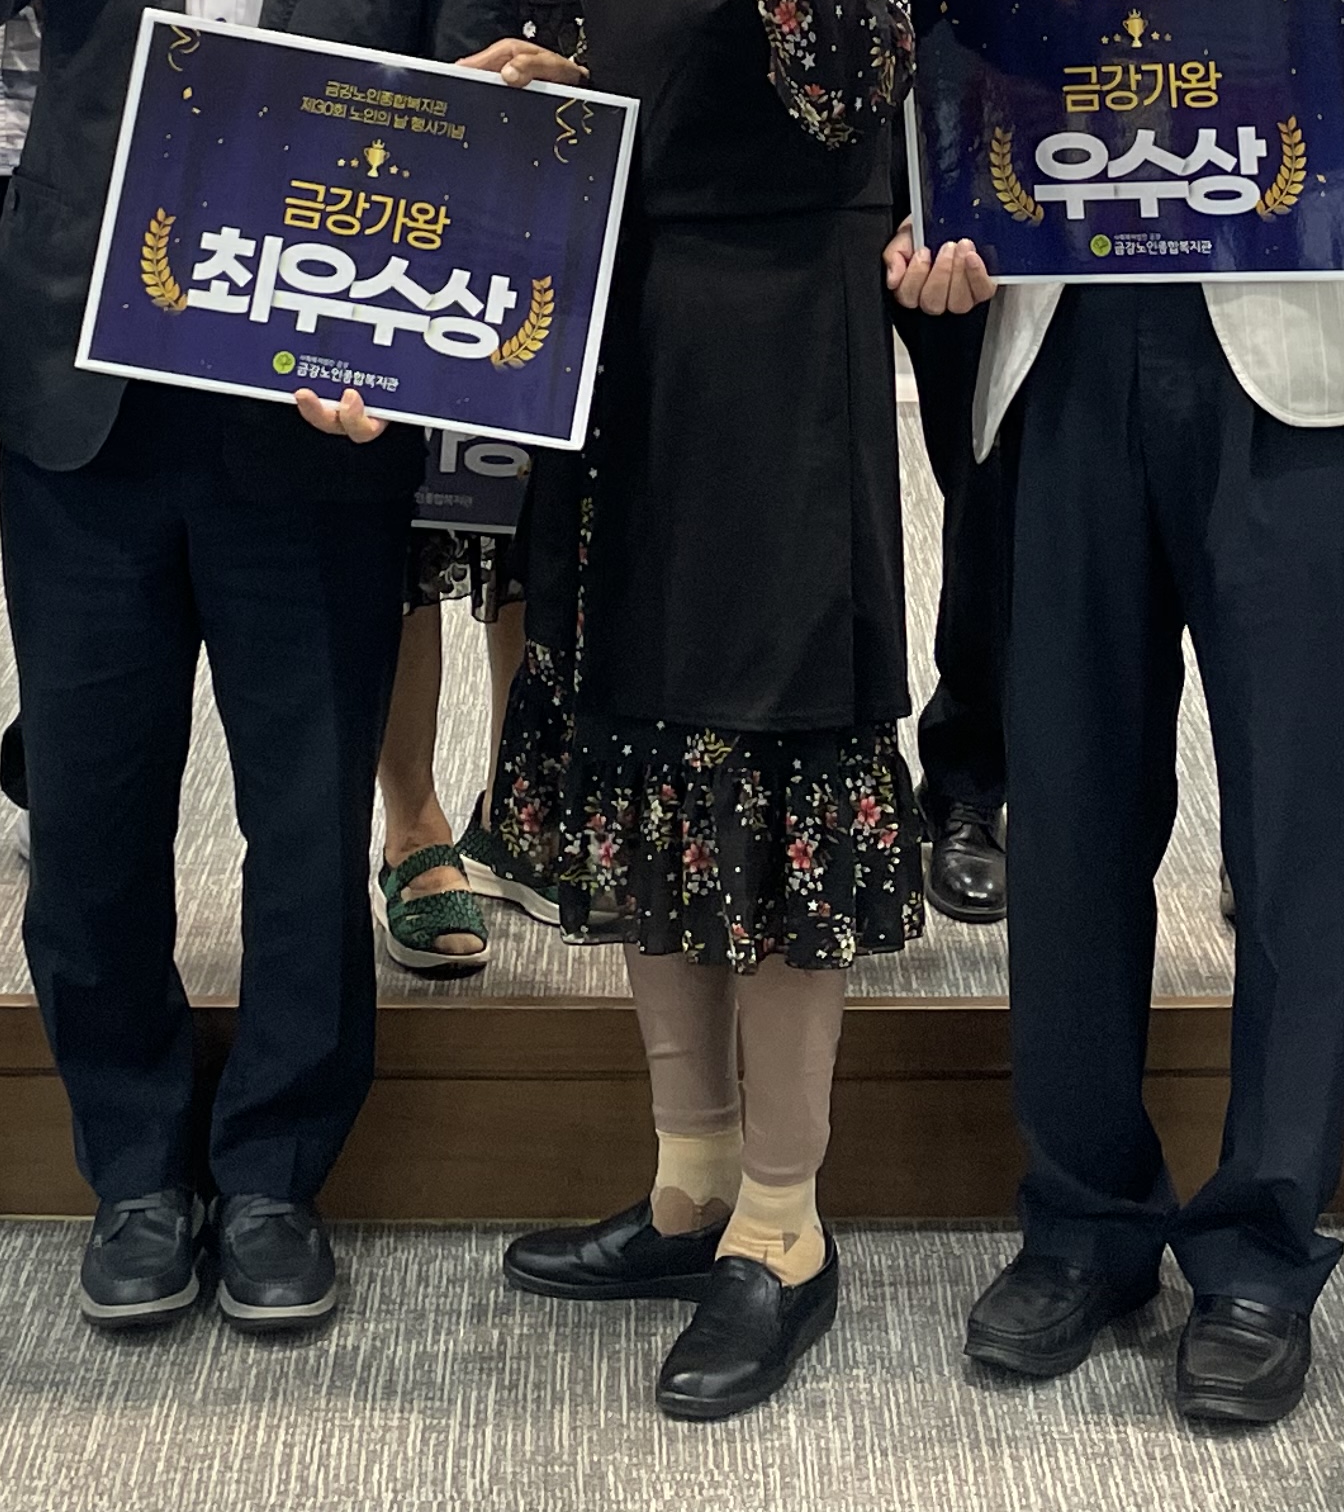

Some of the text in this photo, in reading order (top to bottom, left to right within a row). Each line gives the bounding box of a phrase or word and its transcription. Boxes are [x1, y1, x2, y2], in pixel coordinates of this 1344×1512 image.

[1062, 61, 1223, 113] 금강가왕
[1033, 125, 1267, 220] 우수상
[282, 179, 451, 251] 금강가왕
[186, 226, 518, 360] 최우수상
